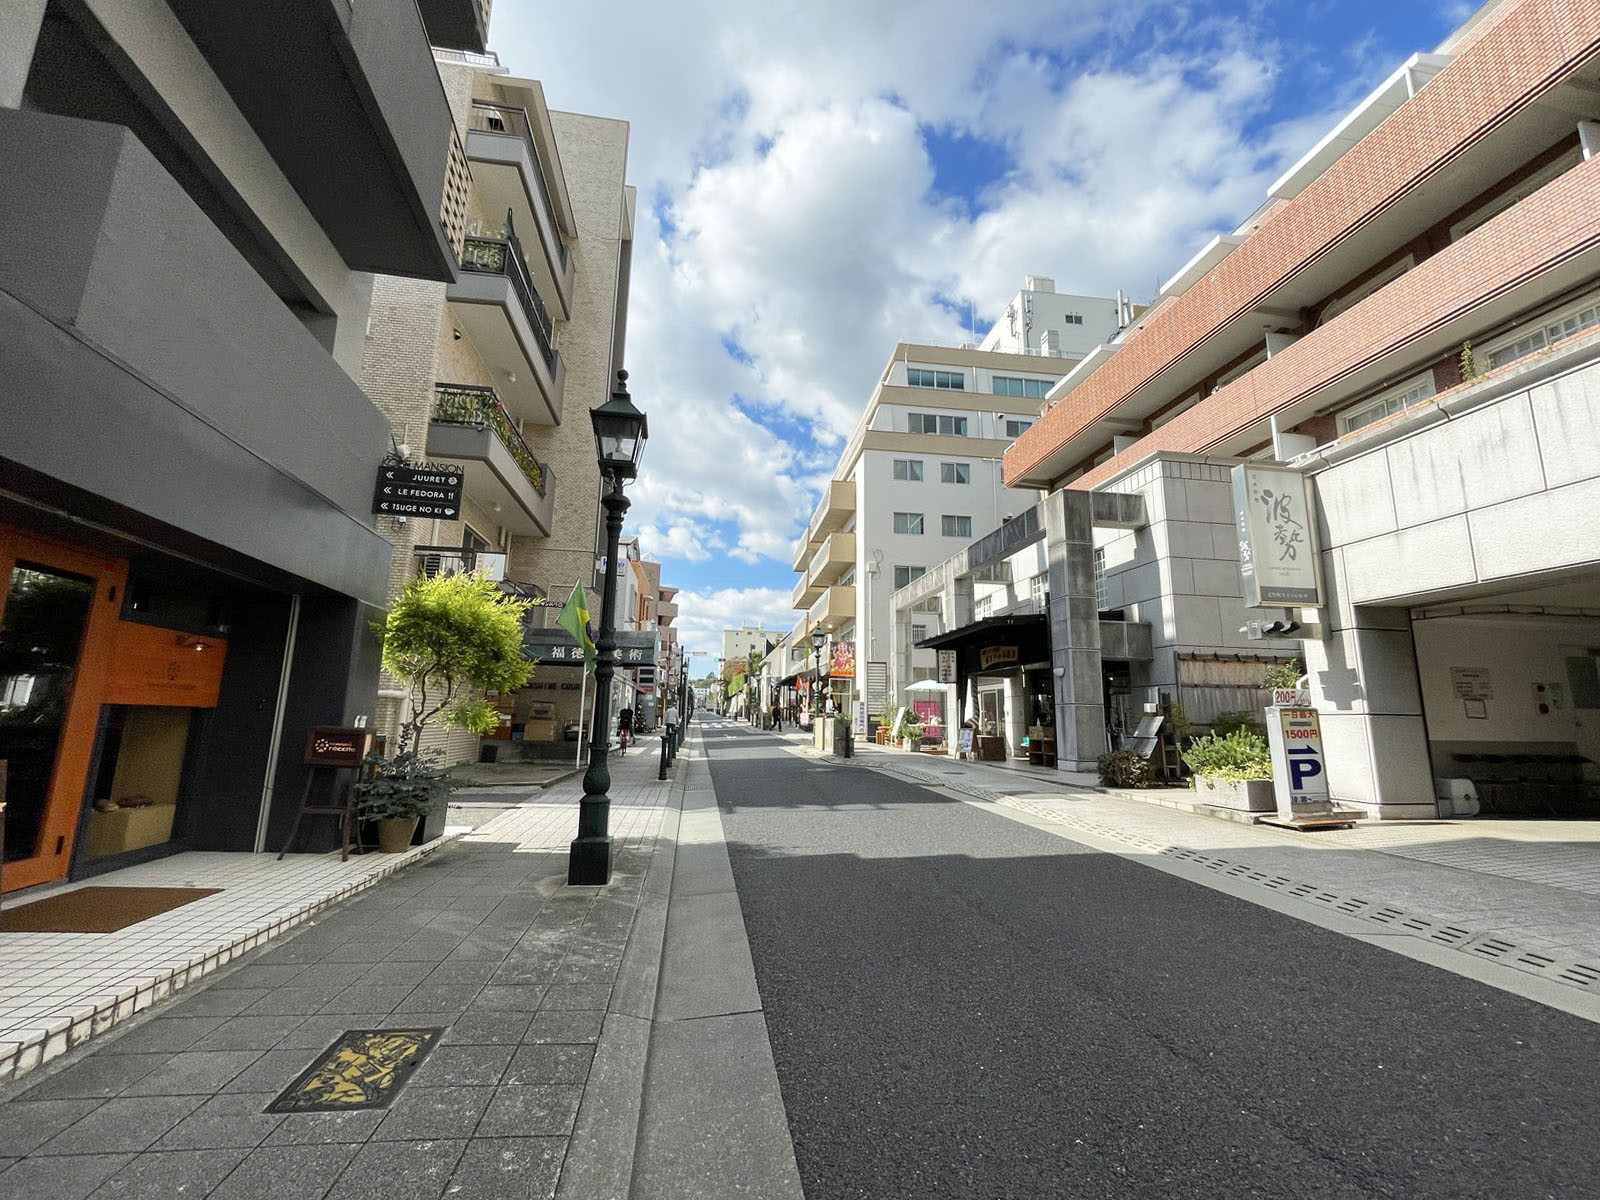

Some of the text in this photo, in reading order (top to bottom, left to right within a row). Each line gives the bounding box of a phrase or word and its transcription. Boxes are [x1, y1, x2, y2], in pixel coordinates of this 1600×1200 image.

[413, 461, 465, 474] MANSION
[412, 474, 446, 484] JUURET
[397, 488, 445, 499] LE FEDORA
[392, 503, 418, 512] TSUGE
[419, 506, 432, 514] NO
[551, 646, 643, 661] 福徳美術
[1285, 729, 1318, 739] 1500円
[1289, 759, 1322, 790] P
